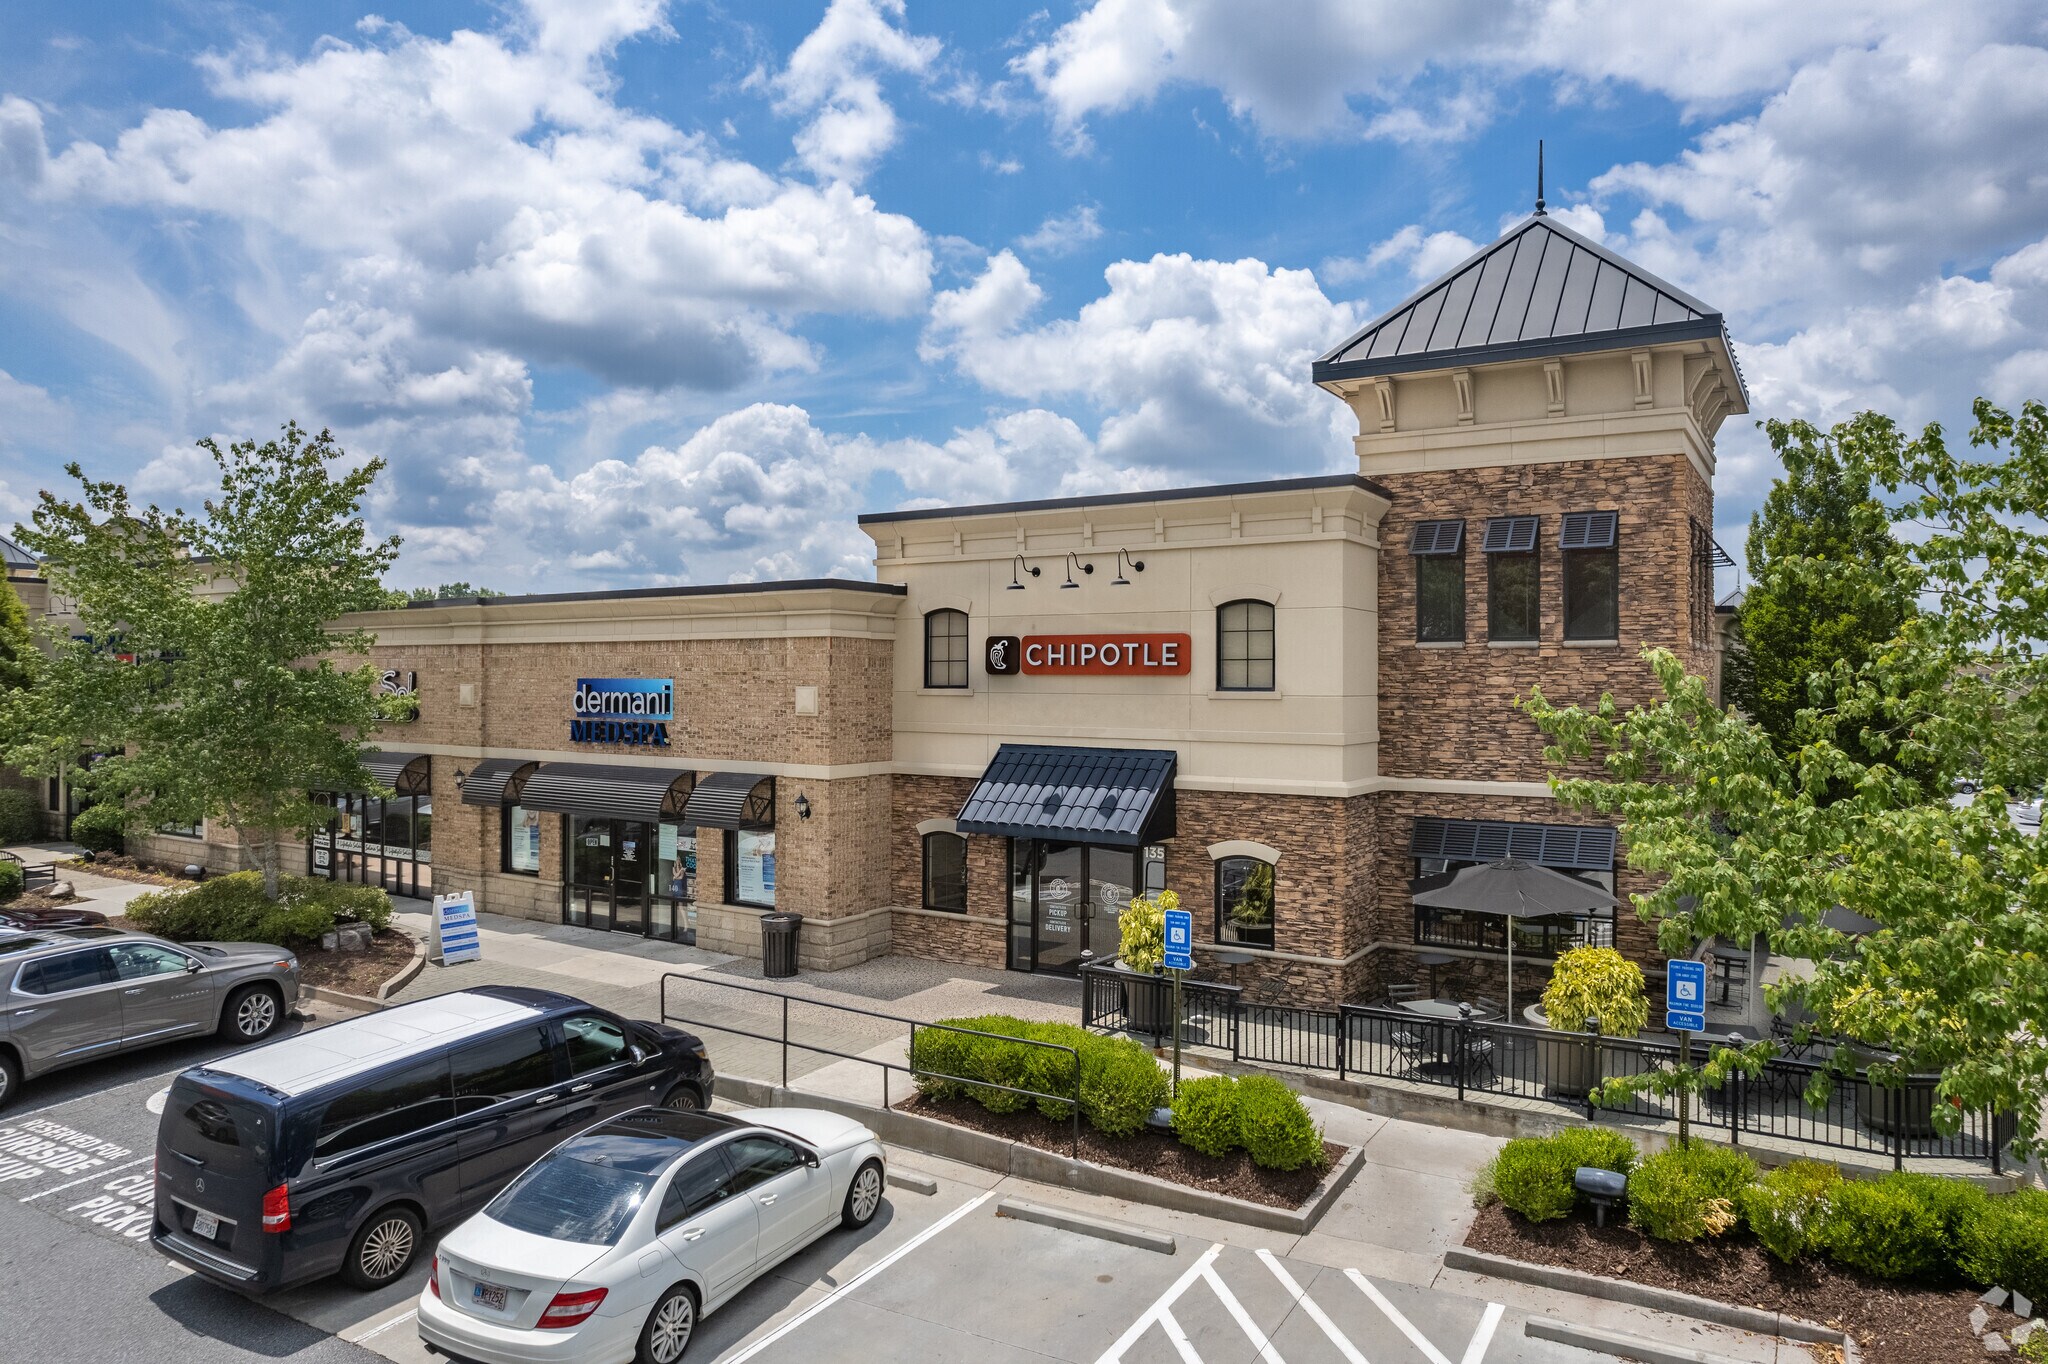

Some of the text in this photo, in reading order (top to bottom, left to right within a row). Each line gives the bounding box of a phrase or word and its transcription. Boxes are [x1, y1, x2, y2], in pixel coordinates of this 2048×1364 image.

[1026, 643, 1178, 667] CHIPOTLE
[572, 684, 668, 715] dermani
[570, 720, 669, 747] MEDSPA
[1144, 846, 1165, 859] 135
[668, 884, 679, 893] 140
[444, 913, 470, 921] MEDSPA
[1049, 909, 1067, 917] PICKUP
[1045, 923, 1071, 933] DELIVERY
[18, 1118, 132, 1160] RESERVED FOR
[66, 1195, 154, 1242] PICKU
